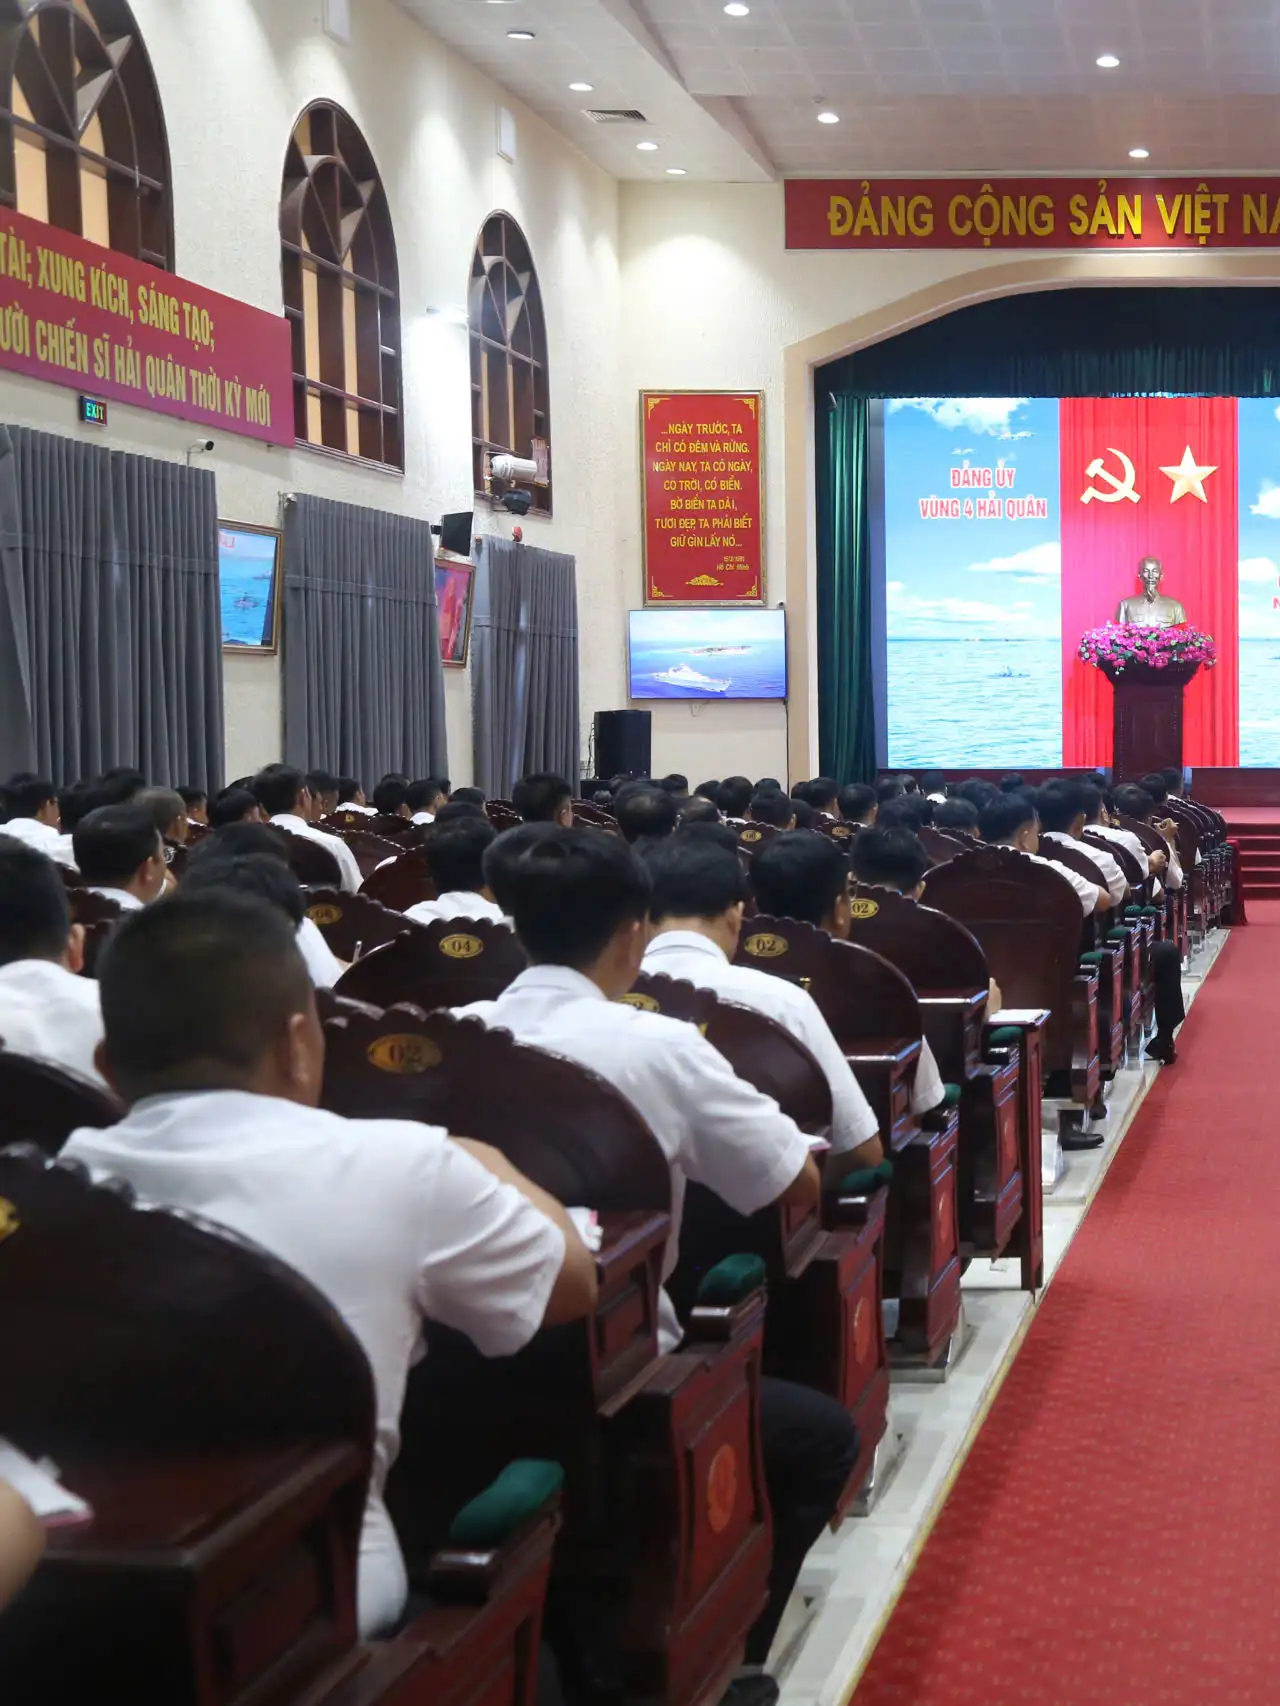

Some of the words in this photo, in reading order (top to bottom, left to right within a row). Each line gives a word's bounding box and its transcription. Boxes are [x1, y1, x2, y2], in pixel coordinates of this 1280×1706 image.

[828, 181, 934, 236] ĐẢNG
[948, 183, 1055, 246] CỘNG
[1069, 179, 1142, 236] SẢN
[1157, 183, 1228, 245] VIỆT
[36, 245, 86, 303] XUNG
[90, 262, 134, 325] KÍCH,
[138, 282, 179, 333] SÁNG
[183, 302, 214, 352] TẠO;
[35, 317, 88, 374] CHIẾN
[94, 333, 110, 381] SĨ
[115, 334, 141, 389] HẢI
[146, 354, 186, 401] QUÂN
[190, 368, 221, 414] THỜI
[225, 376, 241, 418] KỲ
[246, 384, 271, 427] MỚI
[86, 402, 104, 420] EXIT
[731, 424, 742, 434] TA
[674, 439, 686, 453] CÓ
[689, 440, 708, 453] ĐÊM
[710, 440, 721, 453] VÀ
[653, 459, 676, 472] NGÀY
[700, 461, 711, 472] TA
[713, 459, 725, 472] CÓ
[951, 460, 992, 487] ĐẢNG
[996, 459, 1016, 487] ỦY
[704, 476, 717, 490] CÓ
[707, 500, 717, 510] TA
[919, 495, 960, 518] VÙNG
[963, 499, 973, 518] 4
[977, 491, 1002, 518] HẢI
[1006, 495, 1047, 519] QUÂN
[698, 518, 709, 529] TA
[712, 514, 732, 529] PHẢI
[734, 512, 752, 529] BIẾT
[670, 534, 686, 547] GIỮ
[687, 533, 703, 547] GÌN
[705, 532, 721, 547] LẤY
[852, 903, 868, 914] 02
[451, 939, 470, 953] 04
[756, 938, 776, 953] 02
[389, 1042, 422, 1064] 02
